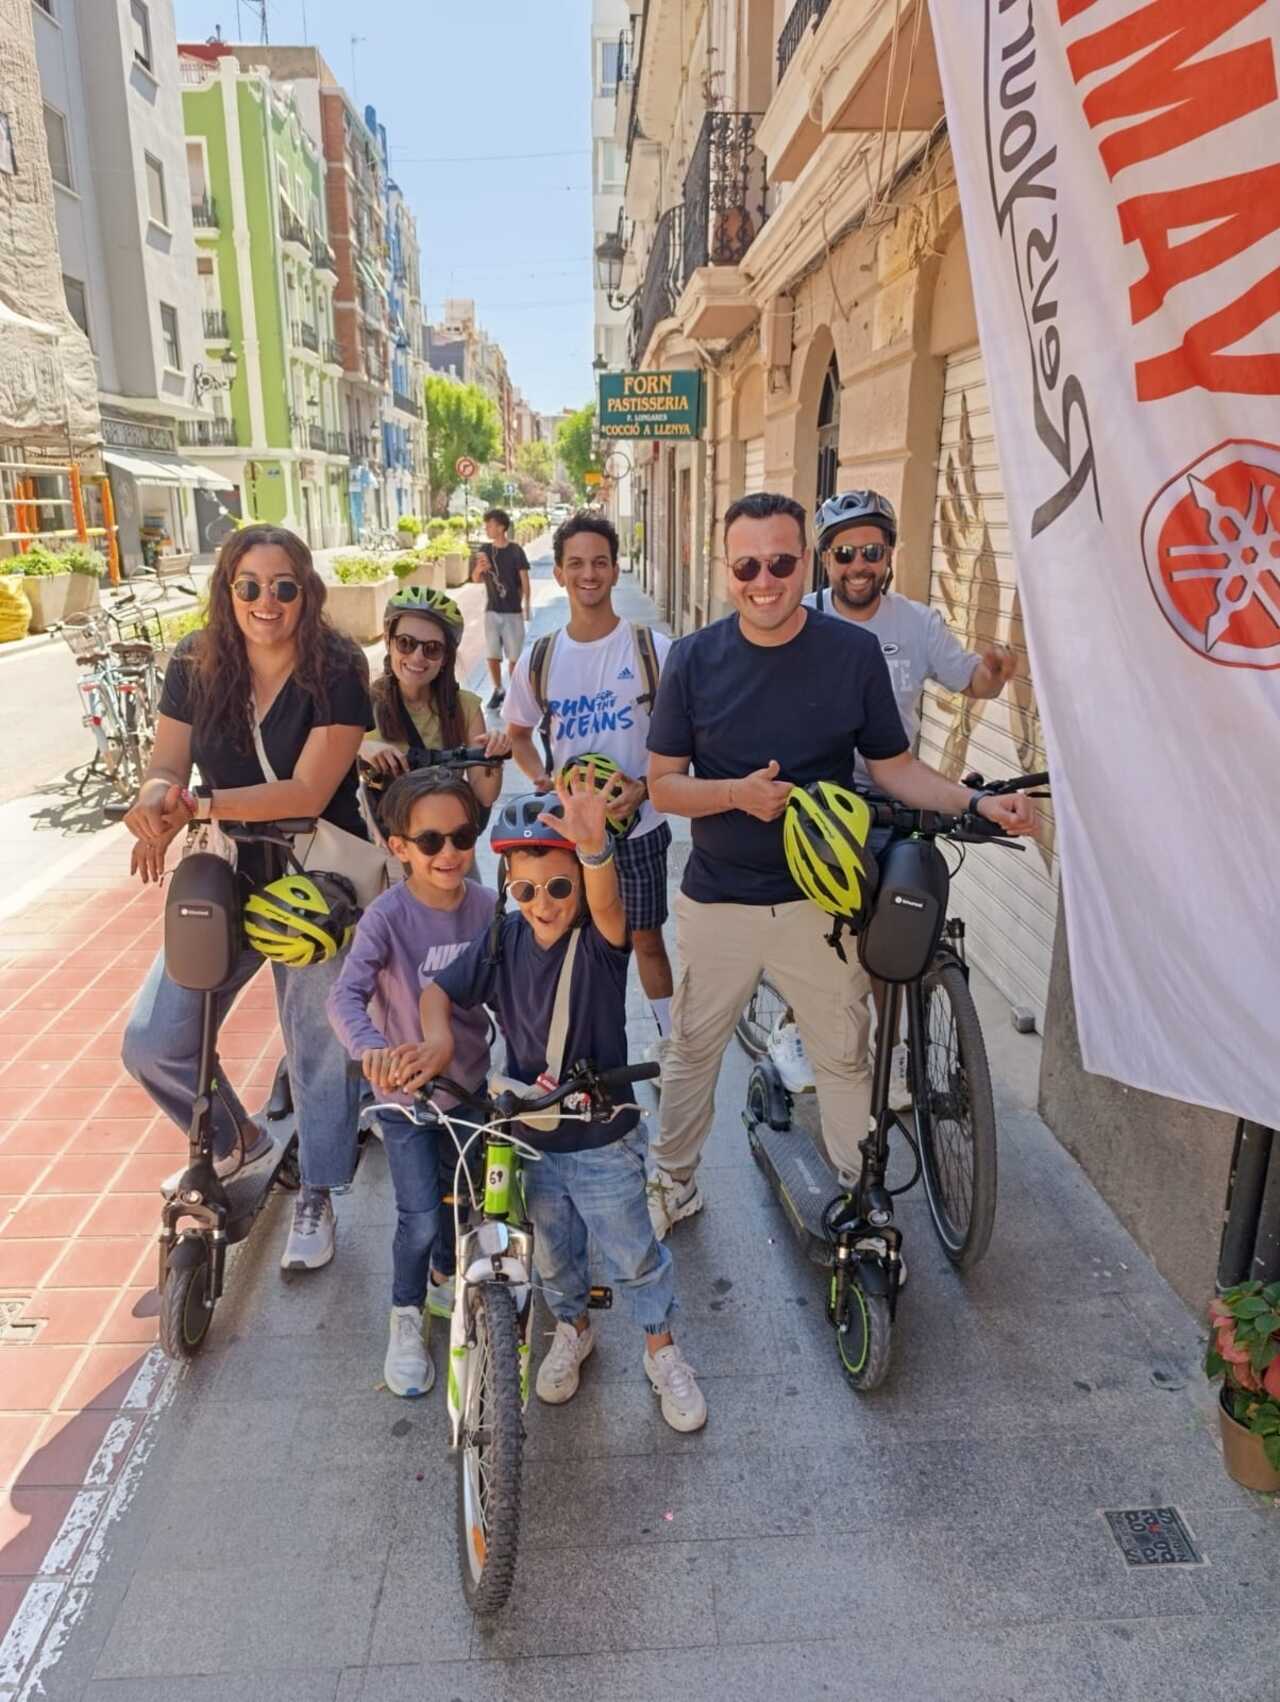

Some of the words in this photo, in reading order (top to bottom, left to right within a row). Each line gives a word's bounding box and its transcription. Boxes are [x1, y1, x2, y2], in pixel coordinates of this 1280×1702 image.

[624, 375, 673, 395] FORN
[607, 396, 689, 413] PASTISSERIA
[643, 424, 652, 436] A
[654, 423, 691, 436] LLENYA
[549, 695, 596, 717] RUN
